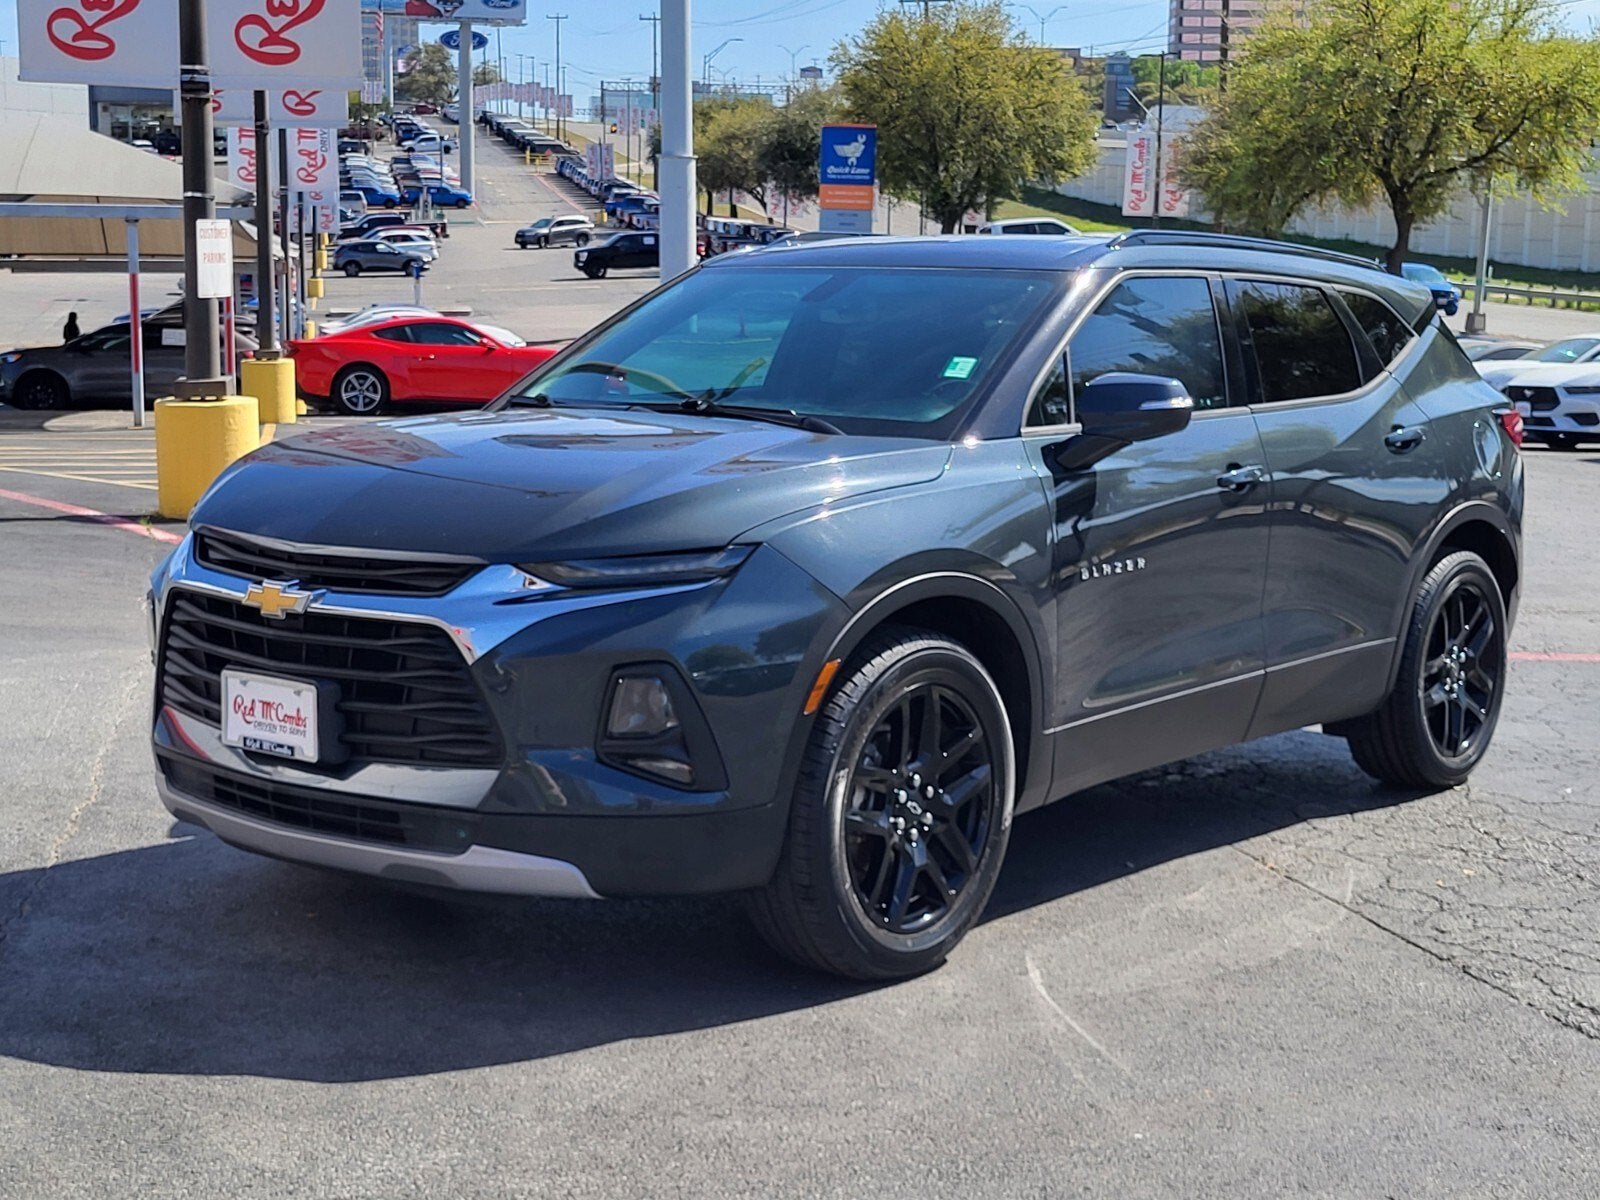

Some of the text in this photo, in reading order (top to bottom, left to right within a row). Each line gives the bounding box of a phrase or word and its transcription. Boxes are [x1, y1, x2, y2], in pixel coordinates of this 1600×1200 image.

[296, 148, 327, 183] Red
[203, 252, 227, 264] PARKING
[1081, 557, 1146, 580] BLAZER
[233, 694, 256, 725] Red
[253, 720, 307, 738] DRIVEN TO SERVE
